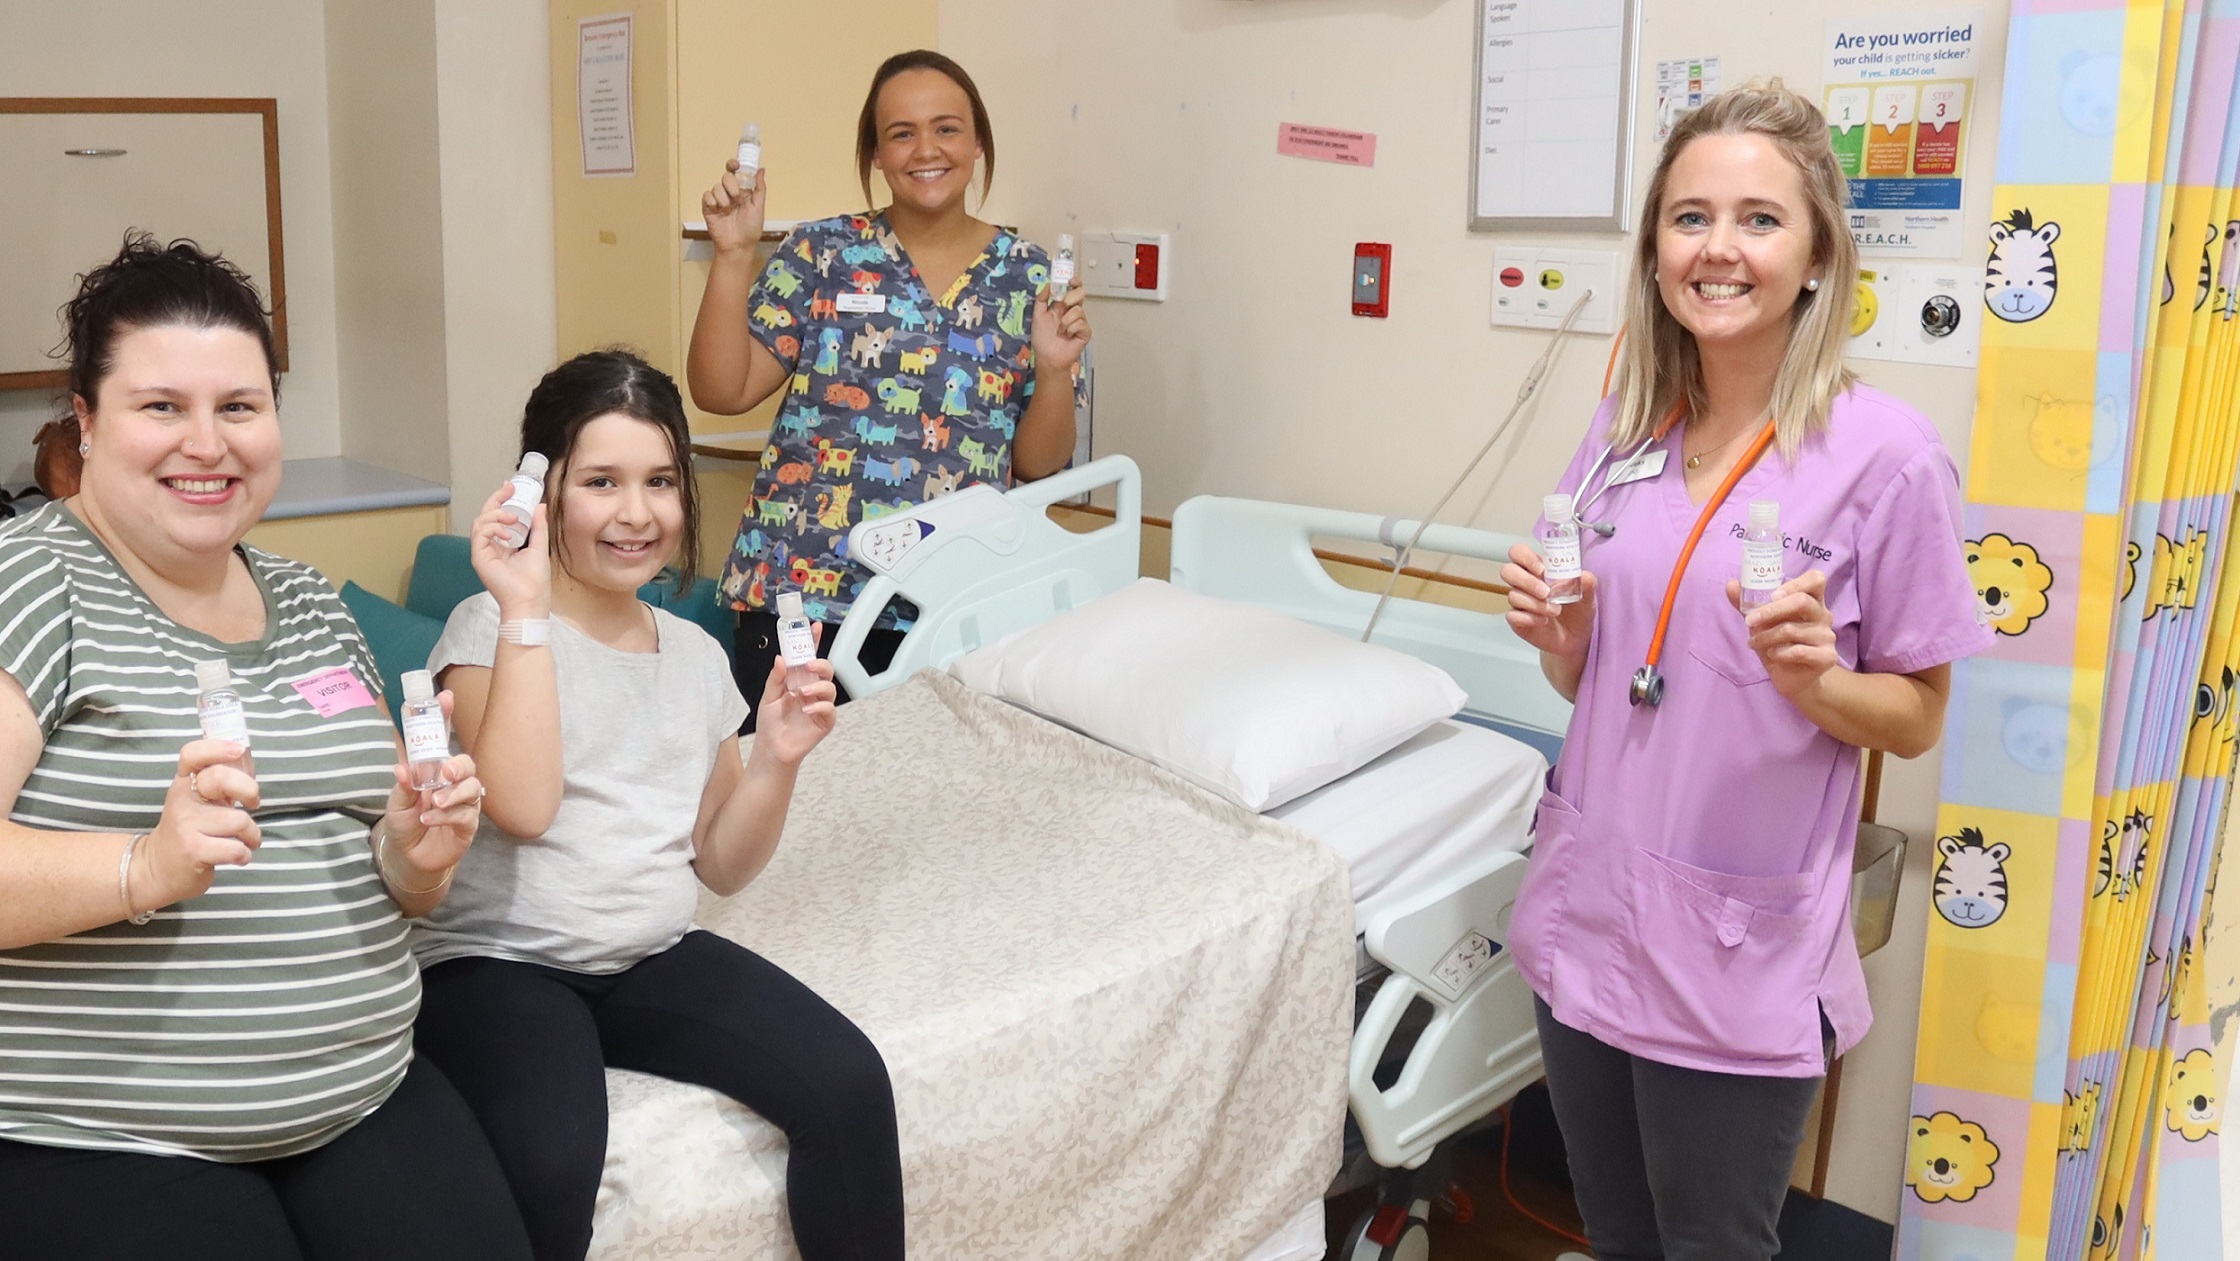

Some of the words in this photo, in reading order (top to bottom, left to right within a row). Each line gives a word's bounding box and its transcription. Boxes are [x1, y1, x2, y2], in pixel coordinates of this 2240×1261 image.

[1835, 32, 1865, 50] Are
[1869, 33, 1899, 50] you
[1903, 24, 1972, 44] worried
[1834, 57, 1856, 68] your
[1858, 53, 1883, 64] child
[1885, 53, 1892, 62] is
[1895, 51, 1931, 64] getting
[1932, 48, 1970, 59] sicker?
[1890, 68, 1919, 76] REACH
[1885, 93, 1906, 102] STEP
[1932, 91, 1953, 101] STEP
[1843, 106, 1850, 120] 1
[1888, 105, 1898, 119] 2
[1936, 103, 1946, 118] 3
[1796, 537, 1832, 561] Nurse
[1548, 556, 1575, 564] KOALA
[317, 682, 353, 696] VISITOR
[410, 734, 439, 743] KOALA
